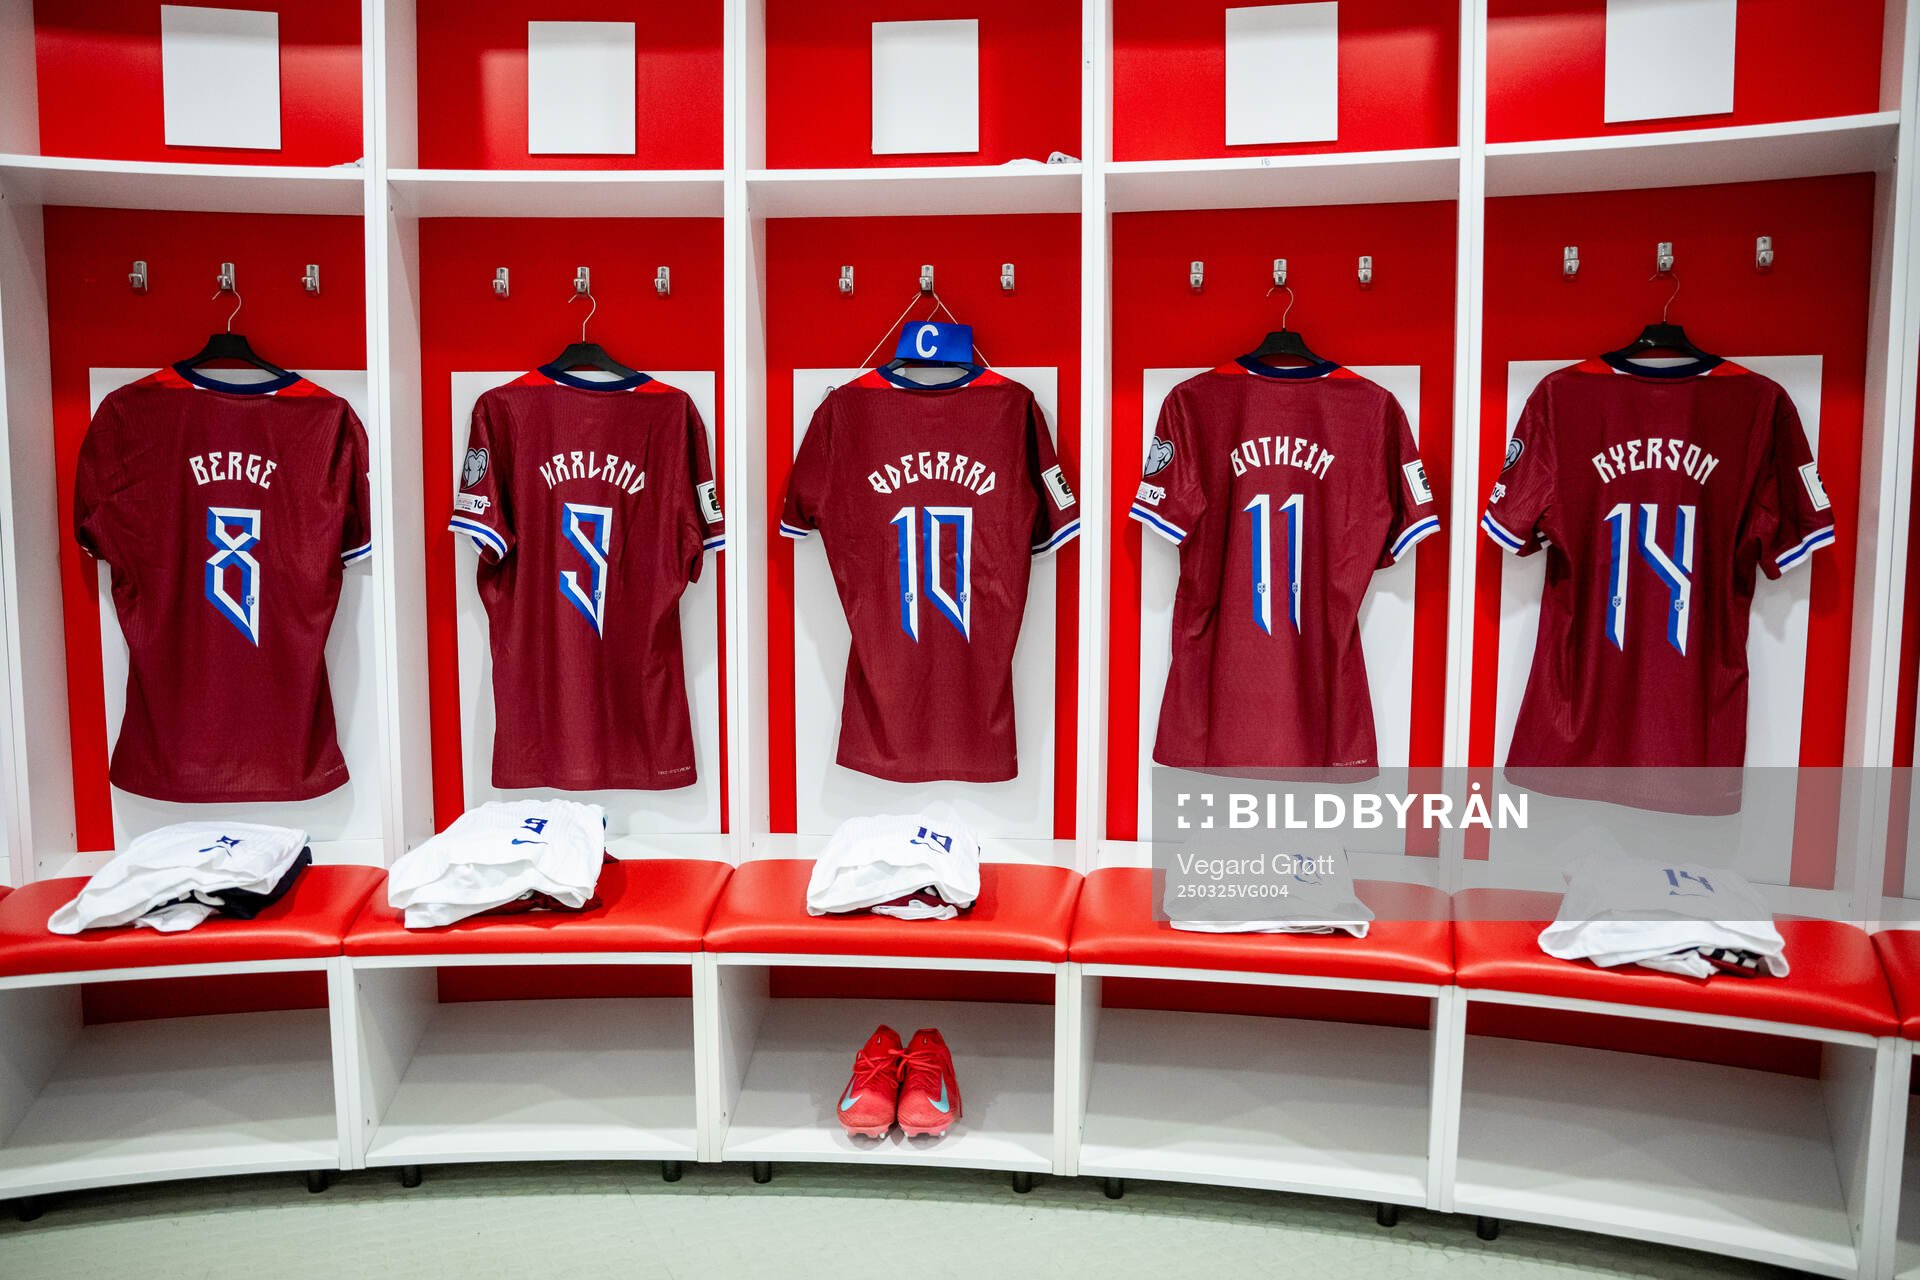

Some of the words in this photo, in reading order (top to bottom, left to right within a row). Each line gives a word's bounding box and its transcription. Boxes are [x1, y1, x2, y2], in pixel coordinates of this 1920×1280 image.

[916, 324, 939, 358] C
[189, 452, 277, 489] BERGE
[539, 450, 645, 495] HAALAND
[1230, 435, 1335, 480] BOTHEIM
[1591, 438, 1719, 485] RYERSON
[205, 506, 261, 648] 8
[559, 502, 613, 641] 9
[888, 506, 973, 645] 10
[1243, 493, 1304, 637] 11
[1603, 503, 1697, 657] 14
